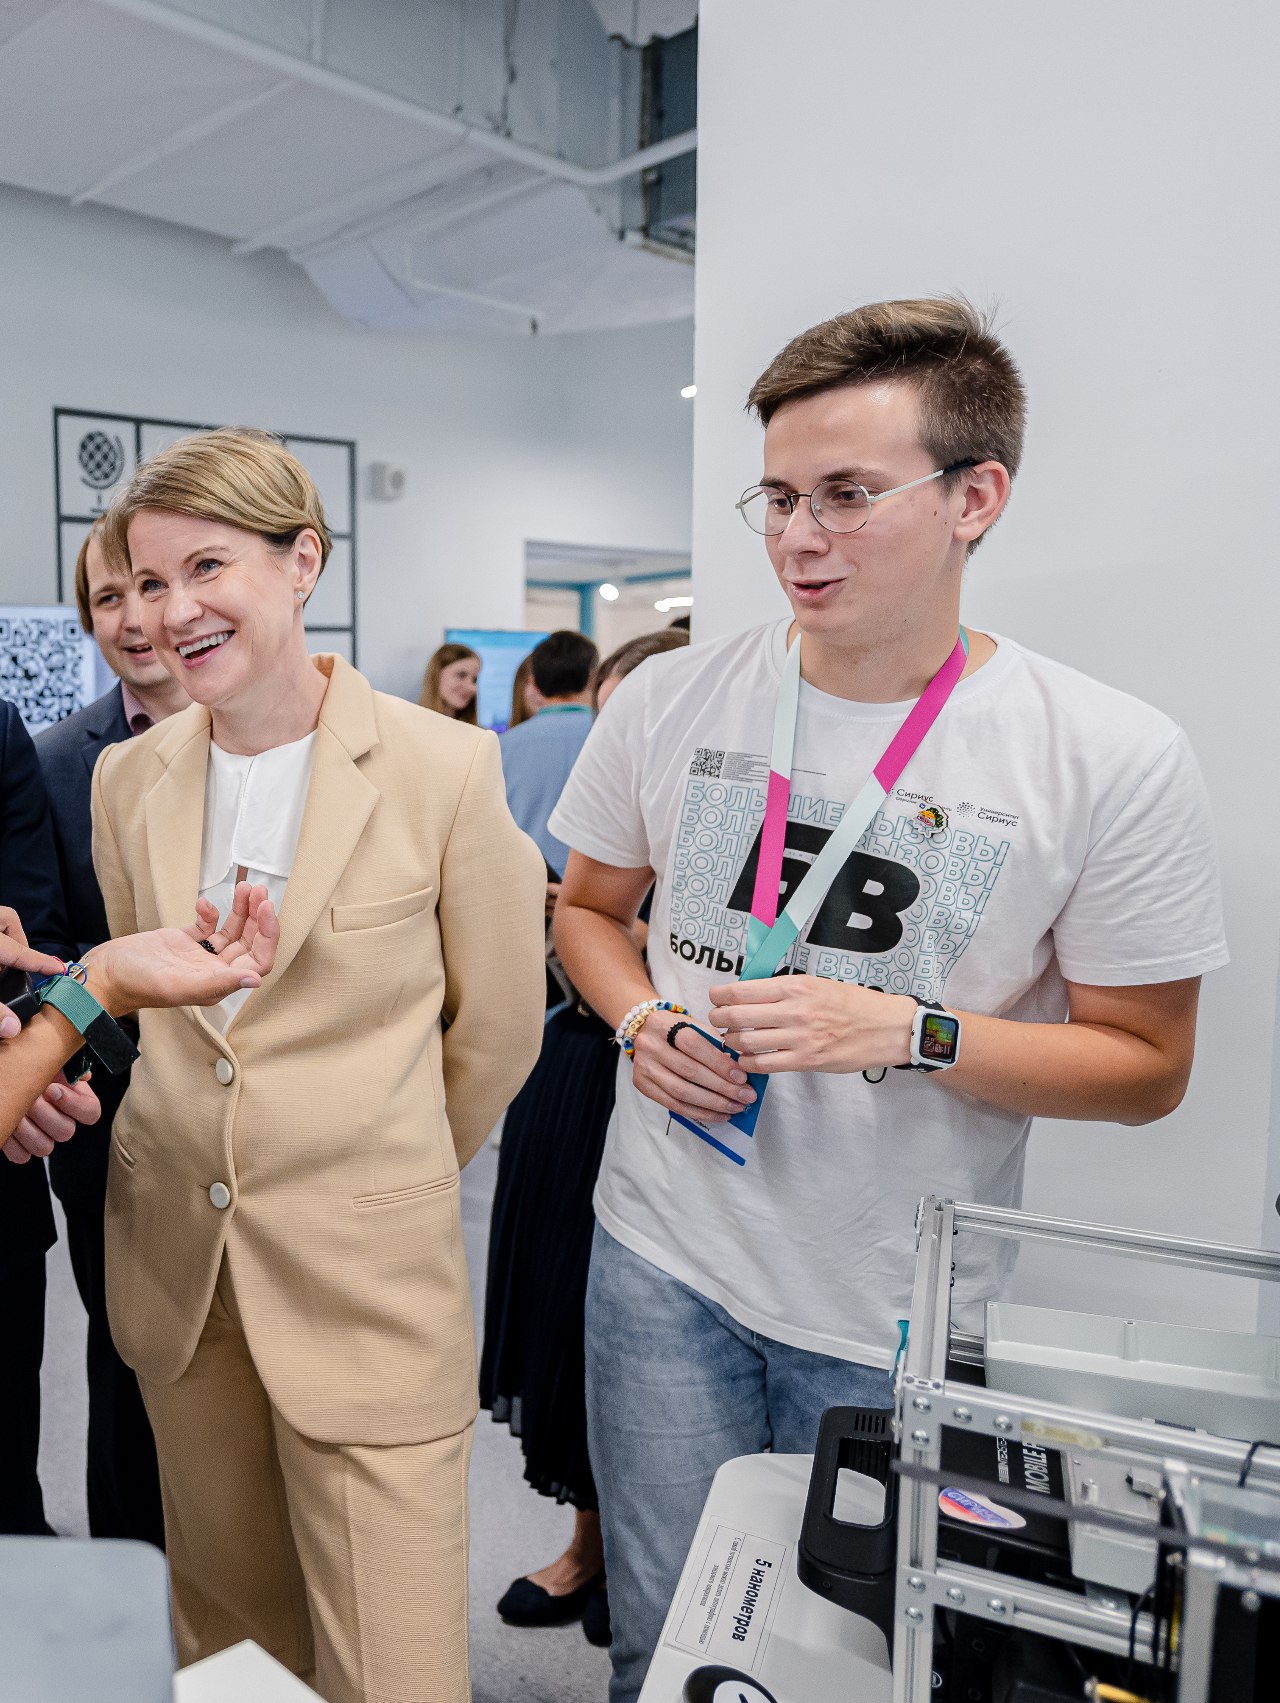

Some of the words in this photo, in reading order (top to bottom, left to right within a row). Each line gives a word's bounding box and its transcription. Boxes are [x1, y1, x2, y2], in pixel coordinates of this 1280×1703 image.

[896, 788, 934, 802] Сириус
[977, 812, 1018, 827] Сириус
[1022, 1448, 1051, 1494] MOBILE
[755, 1558, 773, 1569] 5
[731, 1568, 766, 1642] нанометров
